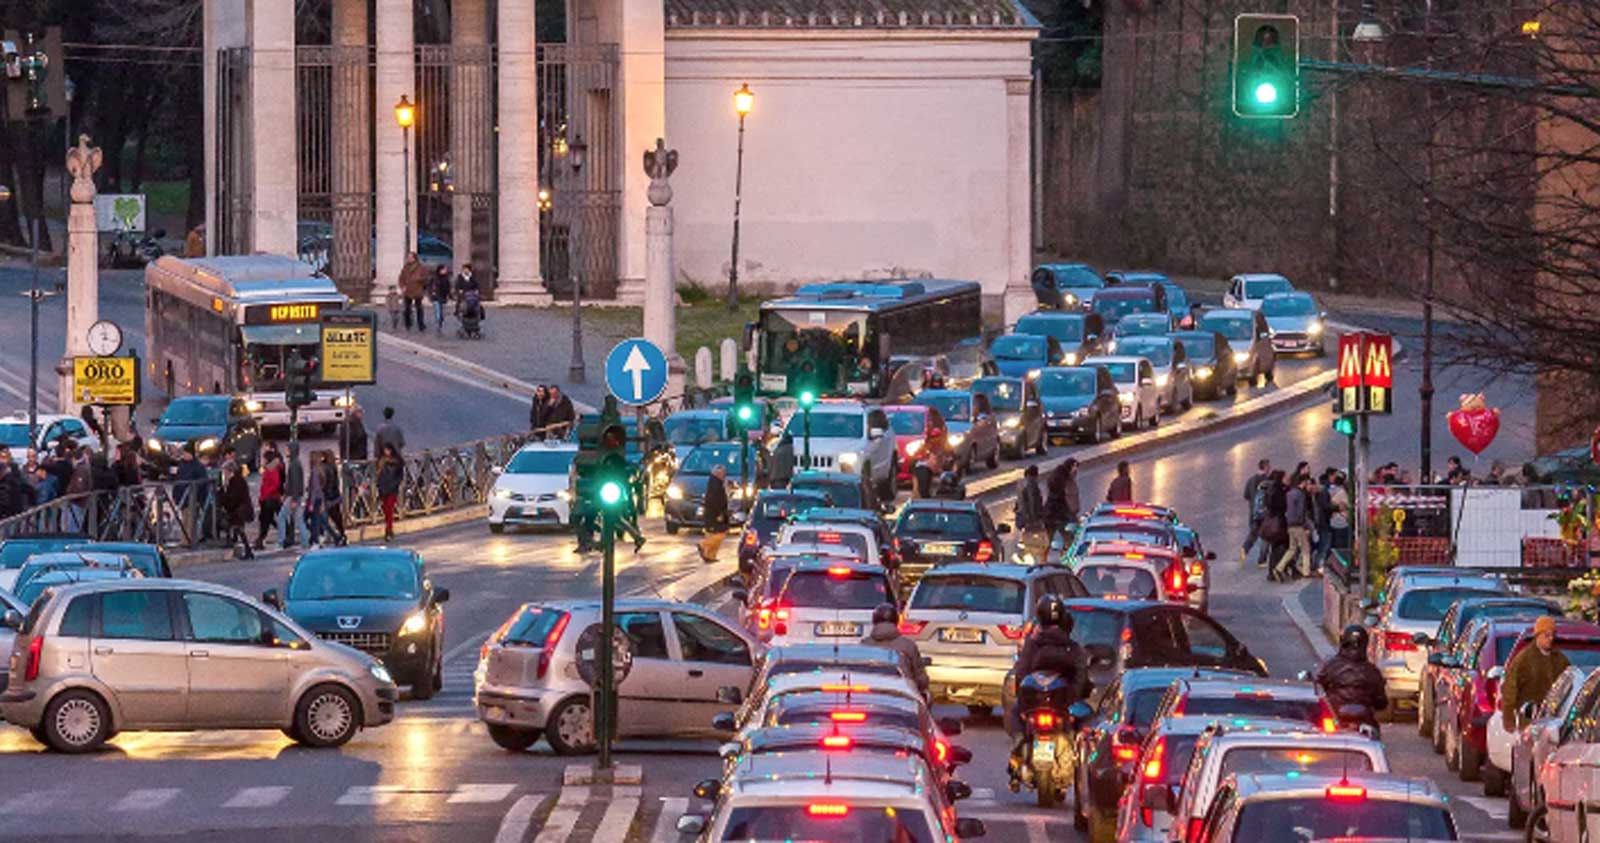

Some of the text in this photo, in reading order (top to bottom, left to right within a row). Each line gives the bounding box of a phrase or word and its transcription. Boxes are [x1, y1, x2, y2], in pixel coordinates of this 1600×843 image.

[84, 364, 124, 379] ORO
[1340, 343, 1361, 377] M
[1365, 342, 1390, 378] M
